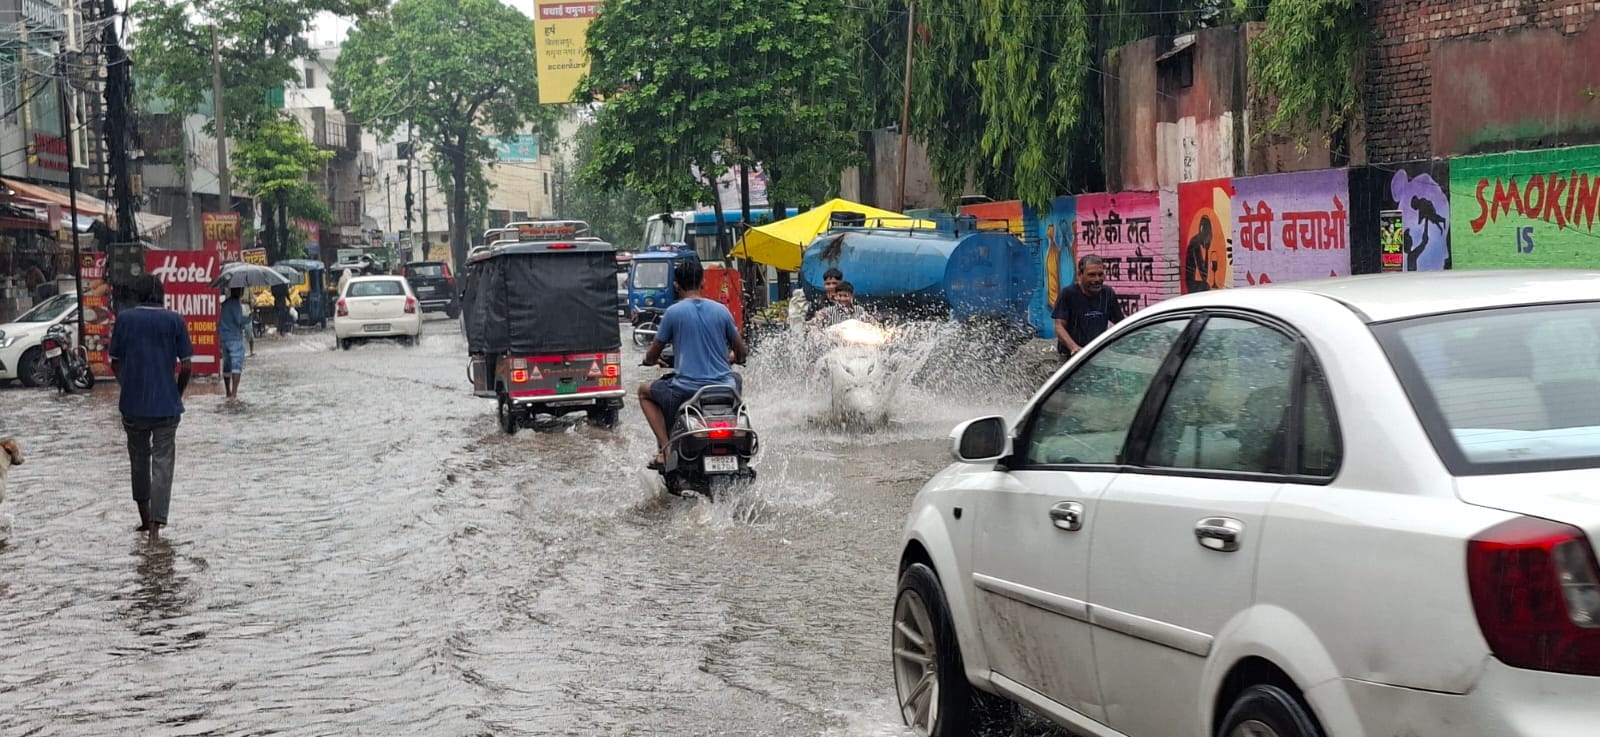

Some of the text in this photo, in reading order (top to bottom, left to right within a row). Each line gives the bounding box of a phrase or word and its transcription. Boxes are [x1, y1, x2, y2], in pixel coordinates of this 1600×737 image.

[565, 6, 586, 17] यमुना
[1470, 169, 1600, 233] SMOKIN
[204, 219, 237, 240] होटल
[1081, 208, 1152, 248] नशे की लत
[1238, 194, 1346, 251] बेटी बचाओ
[216, 240, 228, 250] AC
[1516, 226, 1534, 254] IS
[151, 255, 215, 283] Hotel
[1126, 246, 1153, 283] मौत
[193, 321, 217, 332] ROOMS
[198, 334, 215, 345] HERE
[598, 377, 618, 387] STOP
